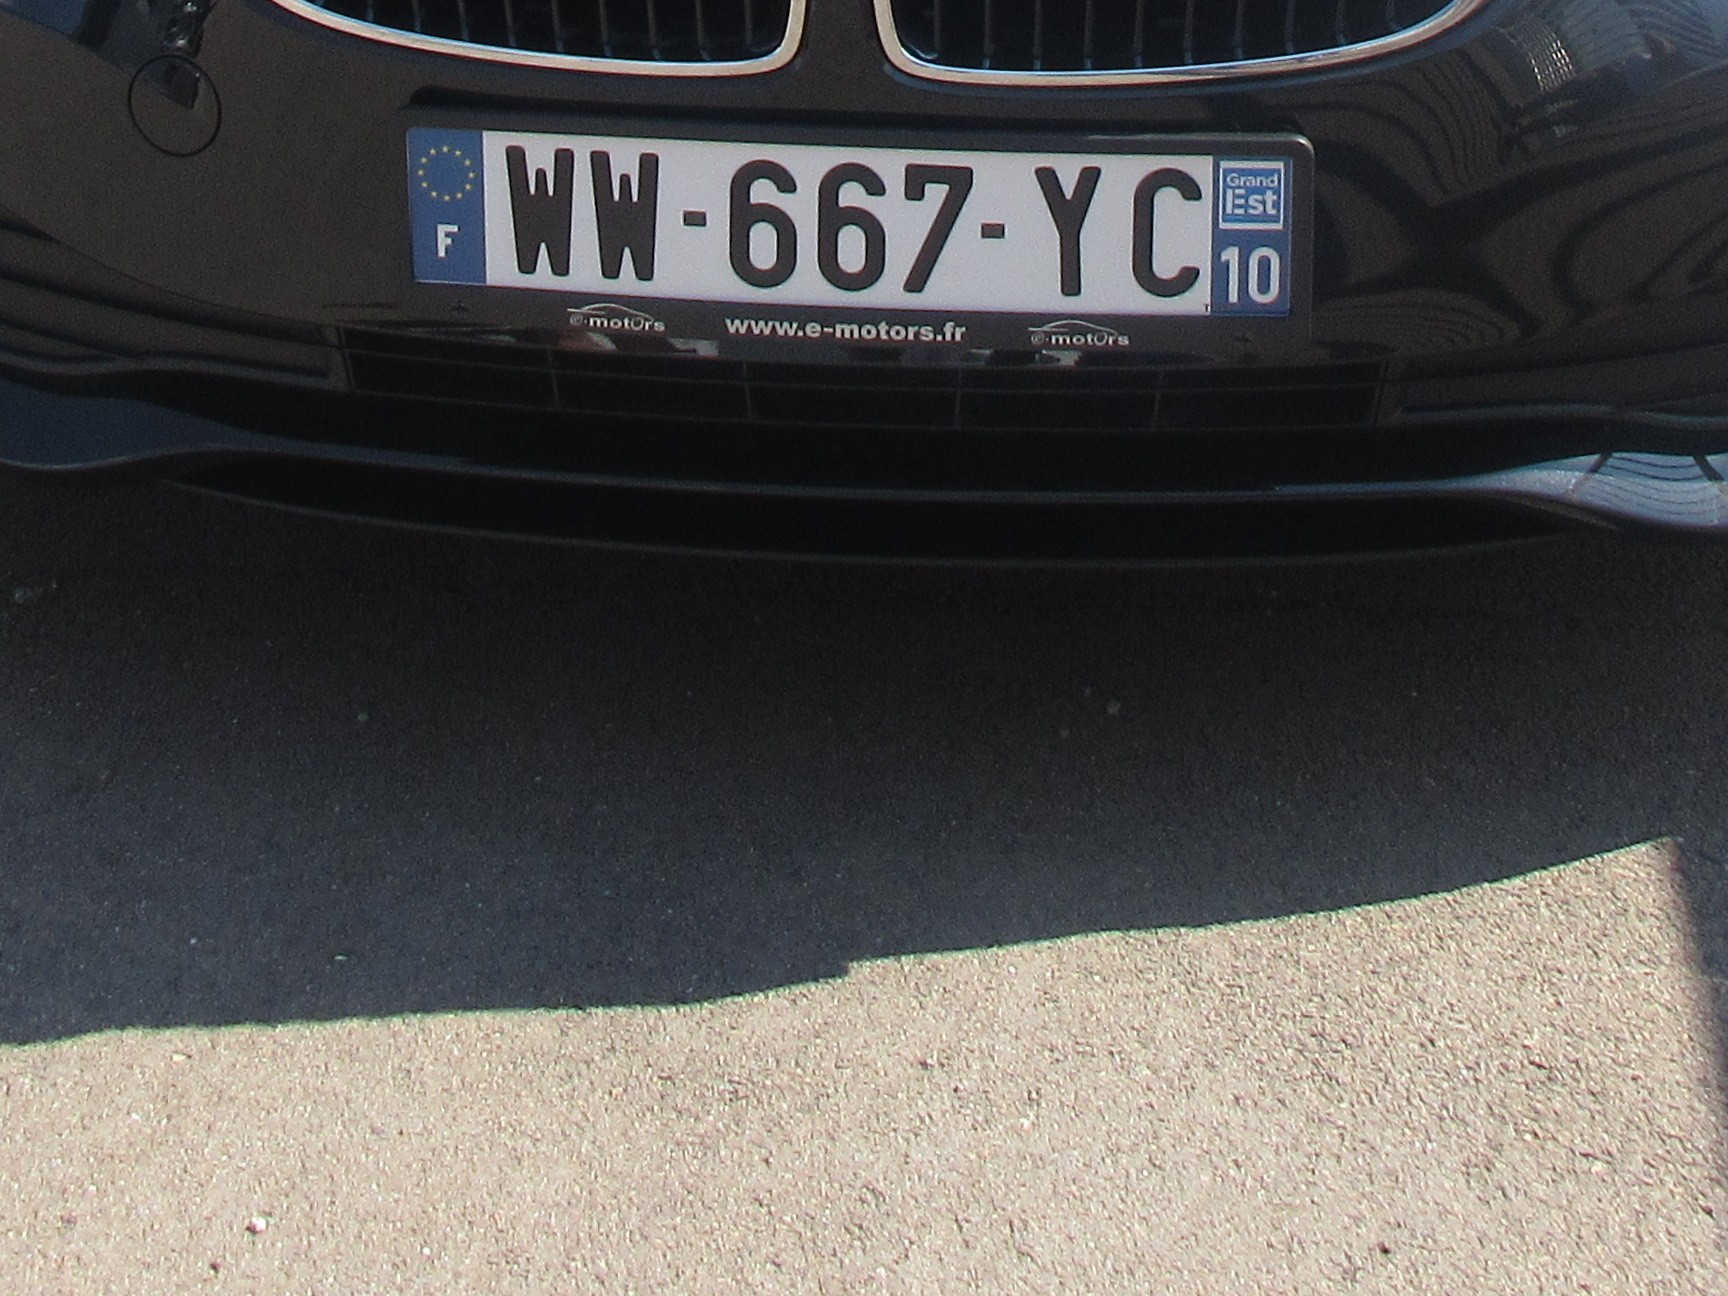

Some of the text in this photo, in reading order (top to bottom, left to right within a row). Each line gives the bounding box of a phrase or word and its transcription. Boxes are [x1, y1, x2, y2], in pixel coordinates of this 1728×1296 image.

[1226, 173, 1279, 188] Grand
[1225, 188, 1278, 215] Est
[435, 222, 460, 258] F
[1220, 245, 1281, 304] 10
[724, 317, 968, 343] www.e-motors.fr
